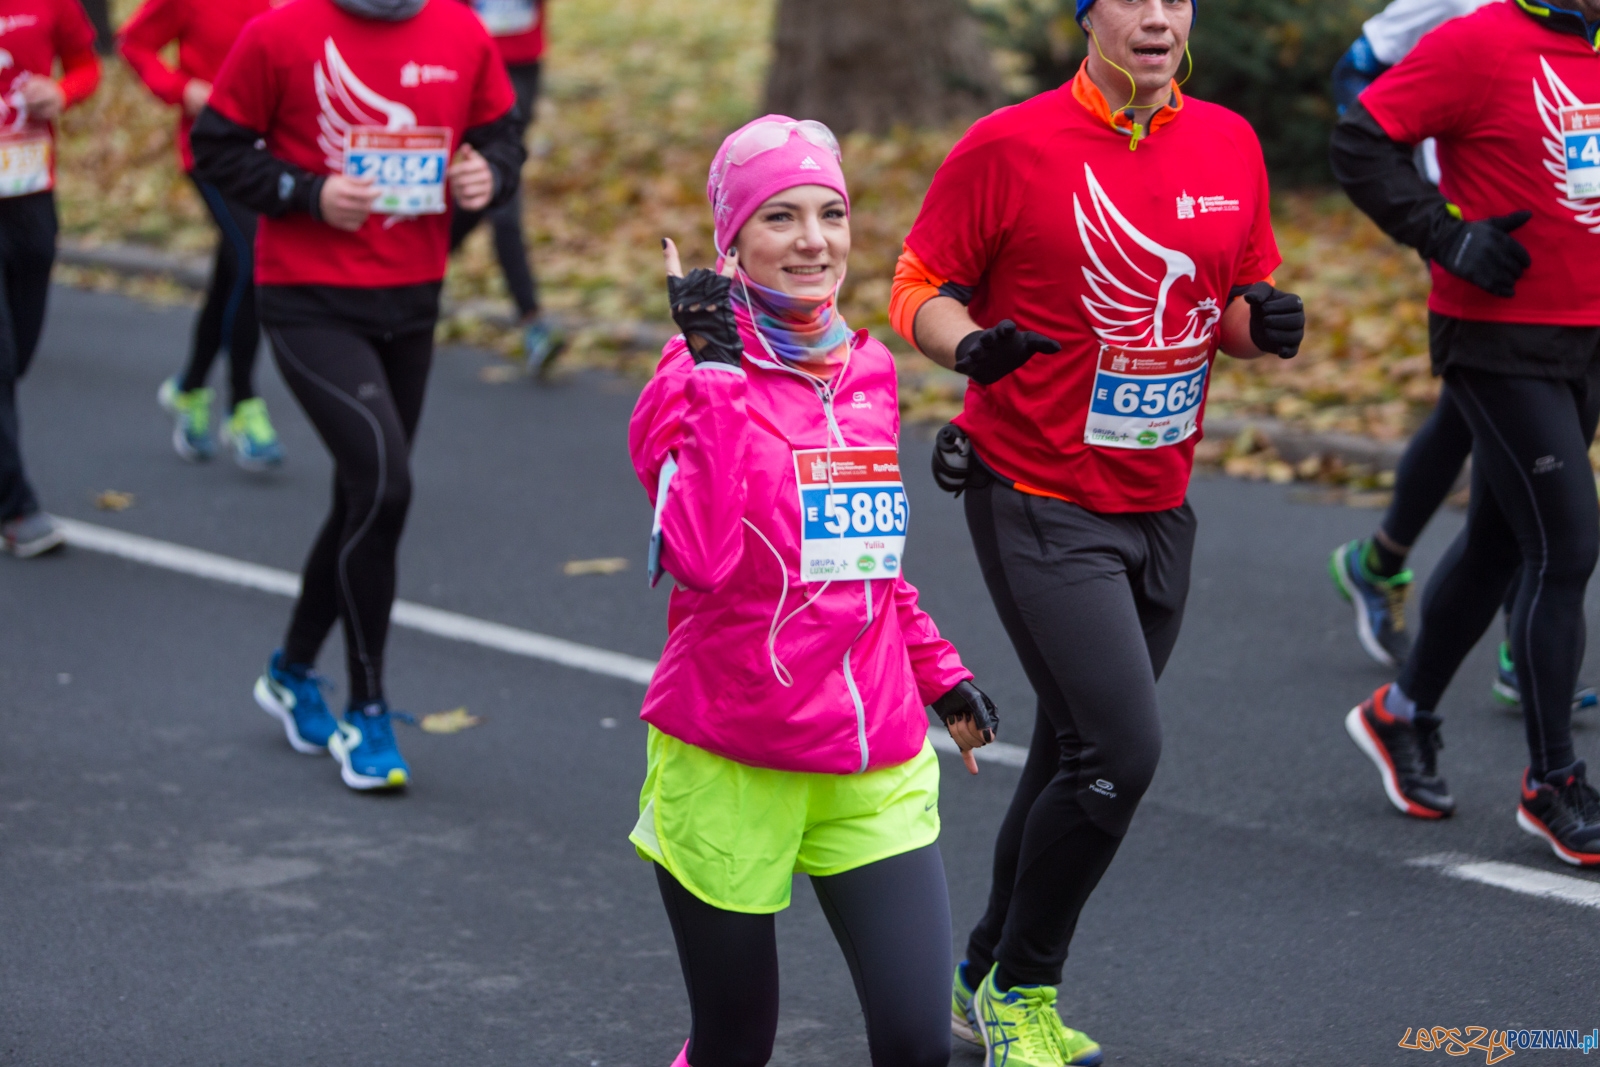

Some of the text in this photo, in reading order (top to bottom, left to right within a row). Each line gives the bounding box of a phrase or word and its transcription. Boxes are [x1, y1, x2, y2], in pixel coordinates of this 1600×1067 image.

[1580, 135, 1600, 166] 4
[360, 155, 437, 182] 2654
[1197, 196, 1208, 213] 1
[1130, 358, 1138, 371] 1
[1096, 373, 1203, 415] E 6565
[1147, 419, 1171, 428] Jacek
[1092, 427, 1116, 436] GRUPA
[830, 461, 839, 476] 1
[807, 492, 906, 534] E 5885
[863, 541, 885, 550] Yuliia
[809, 559, 835, 567] GRUPA
